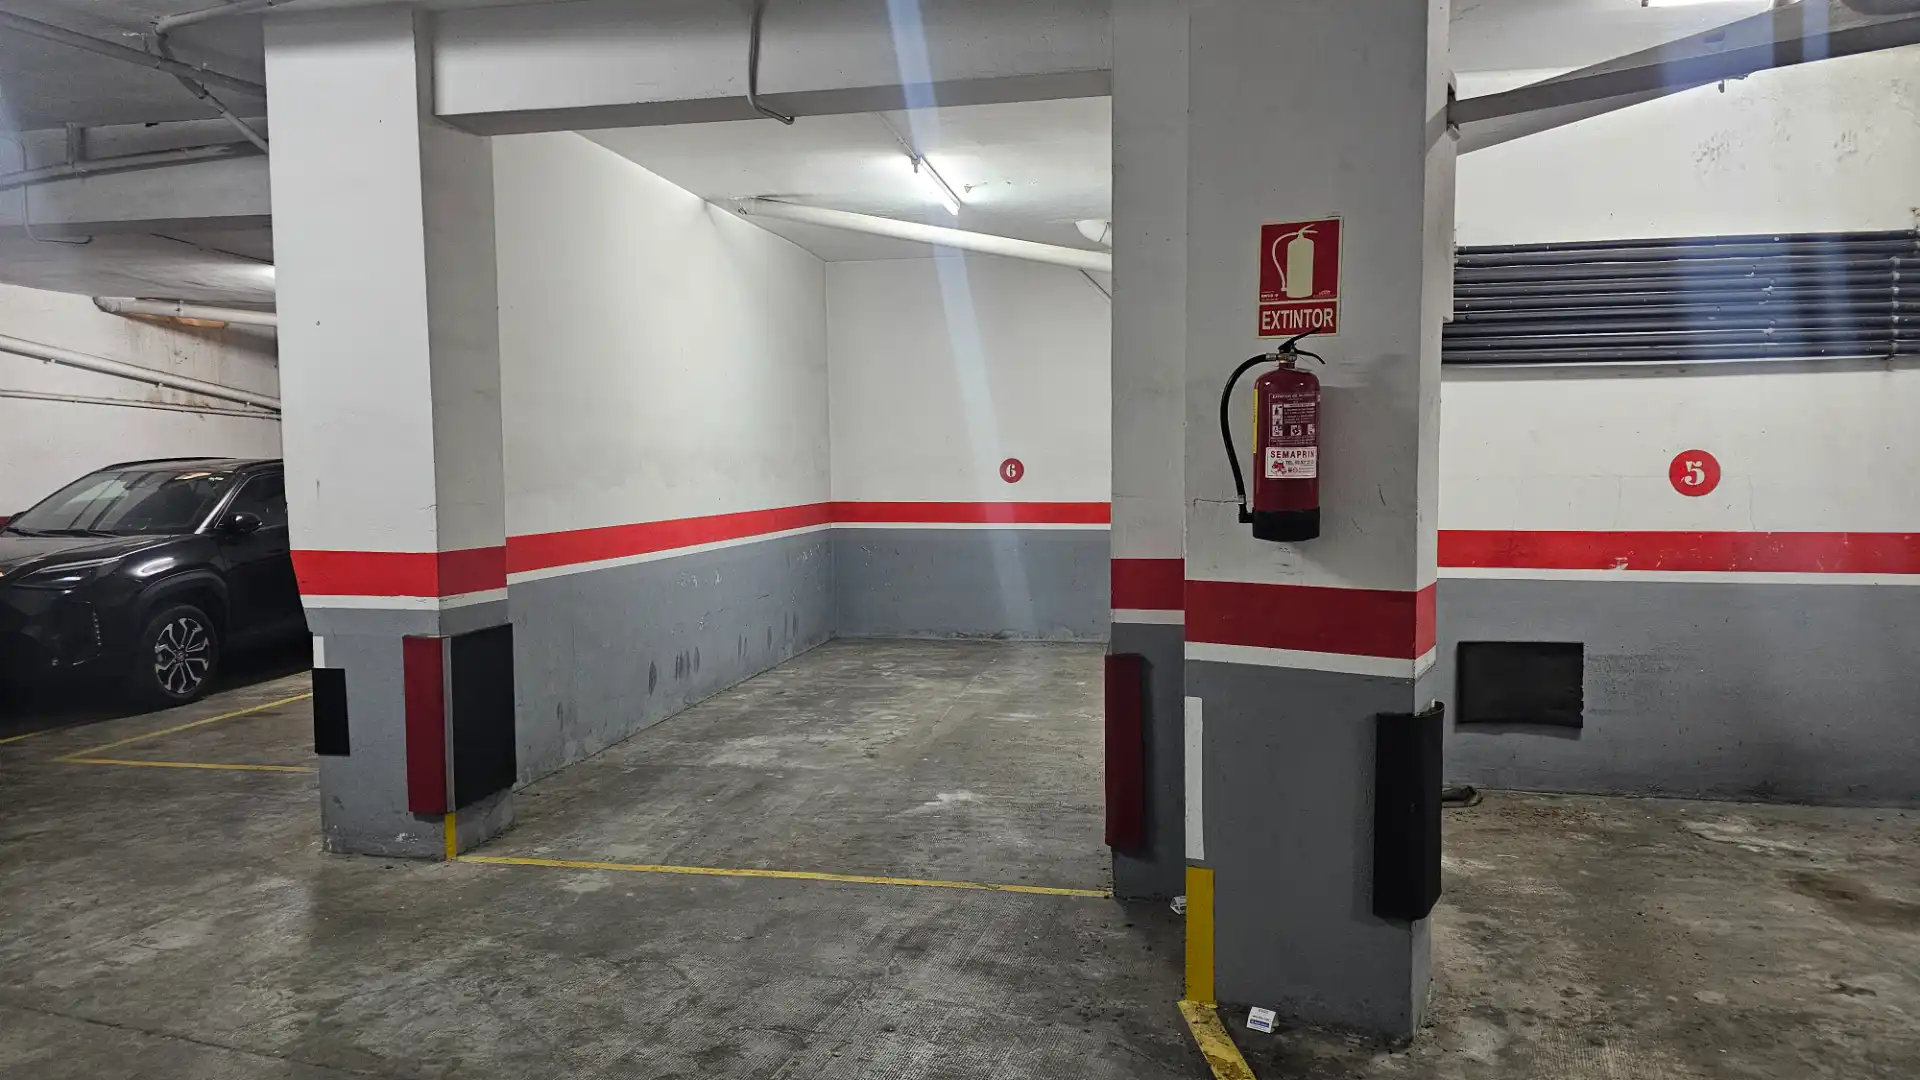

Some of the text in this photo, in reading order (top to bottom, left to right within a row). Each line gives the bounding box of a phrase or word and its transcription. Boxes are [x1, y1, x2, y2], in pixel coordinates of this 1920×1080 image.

[1262, 308, 1334, 330] EXTINTOR
[1270, 450, 1315, 459] SEMAPRIN
[1005, 463, 1016, 477] 6
[1685, 460, 1705, 485] 5
